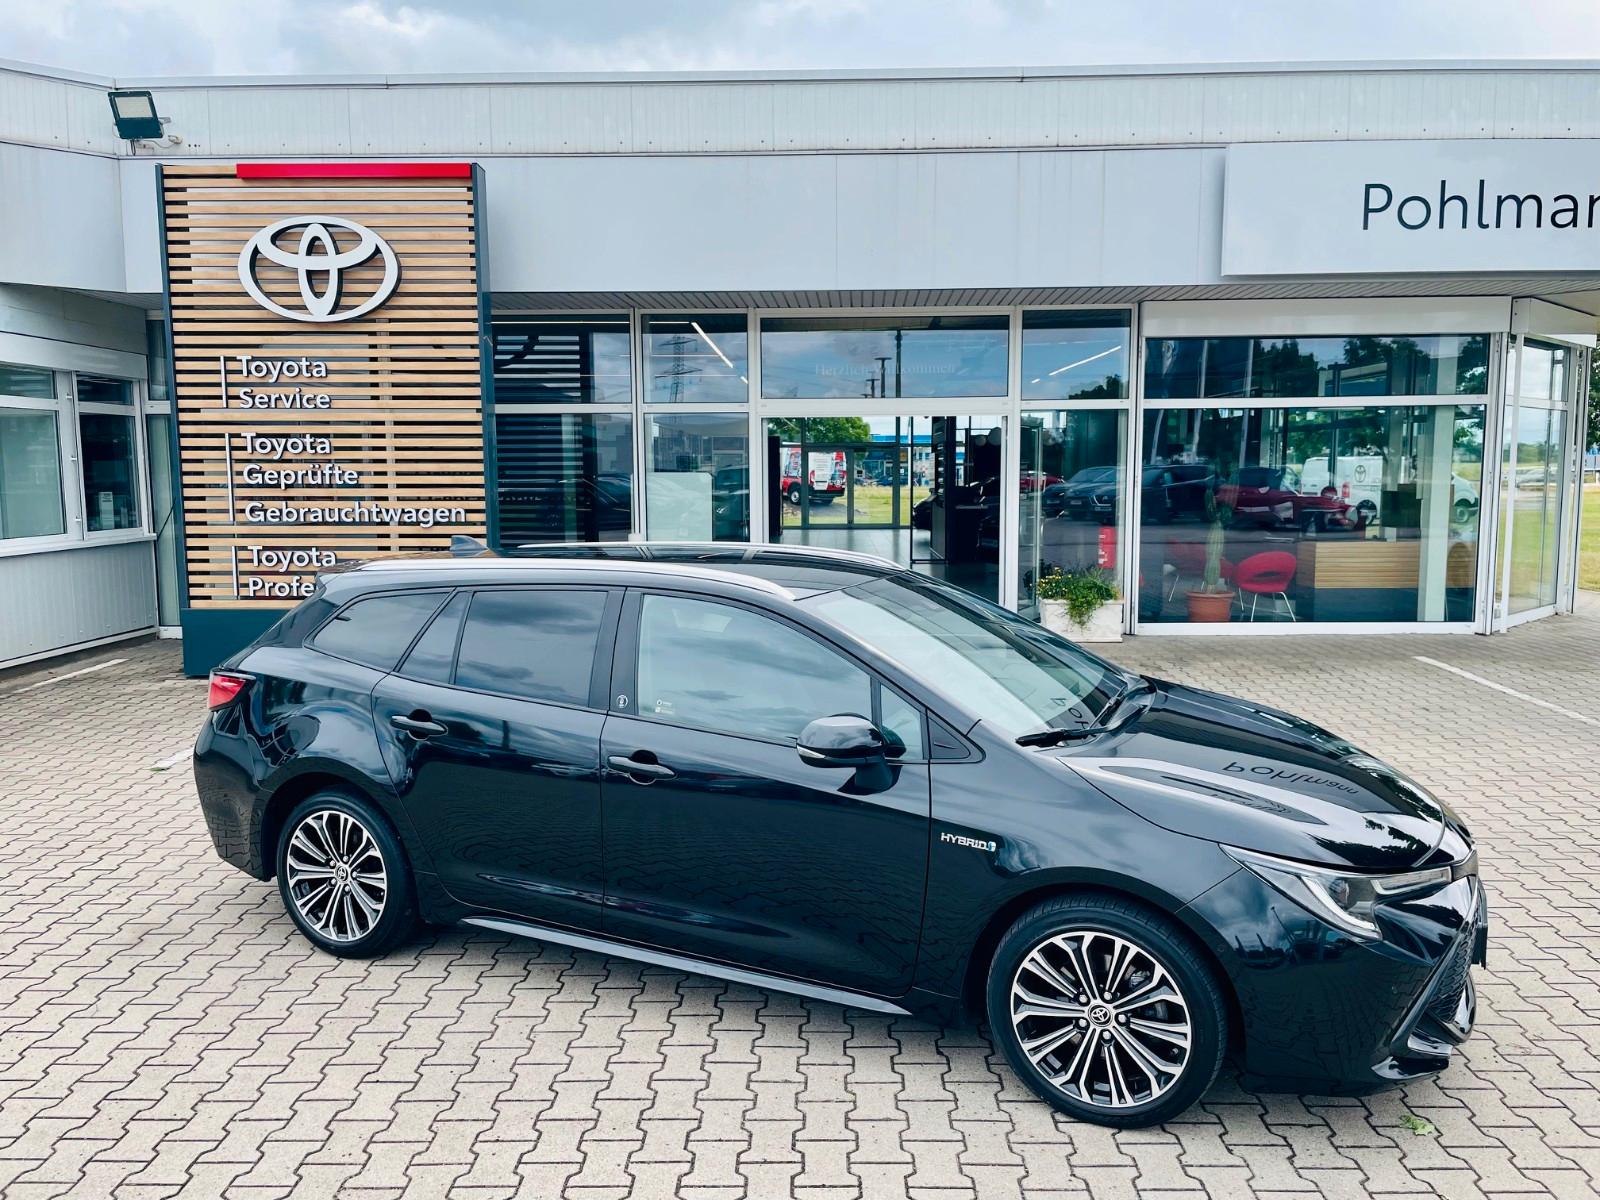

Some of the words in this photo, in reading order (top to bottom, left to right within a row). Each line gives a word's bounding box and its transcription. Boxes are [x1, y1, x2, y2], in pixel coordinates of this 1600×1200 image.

[236, 355, 328, 383] Toyota
[239, 388, 331, 409] Service
[241, 432, 332, 460] Toyota
[243, 464, 359, 490] Geprüfte
[245, 501, 467, 528] Gebrauchtwagen
[248, 545, 337, 573] Toyota
[249, 576, 318, 597] Profe
[940, 832, 989, 851] HYBRID
